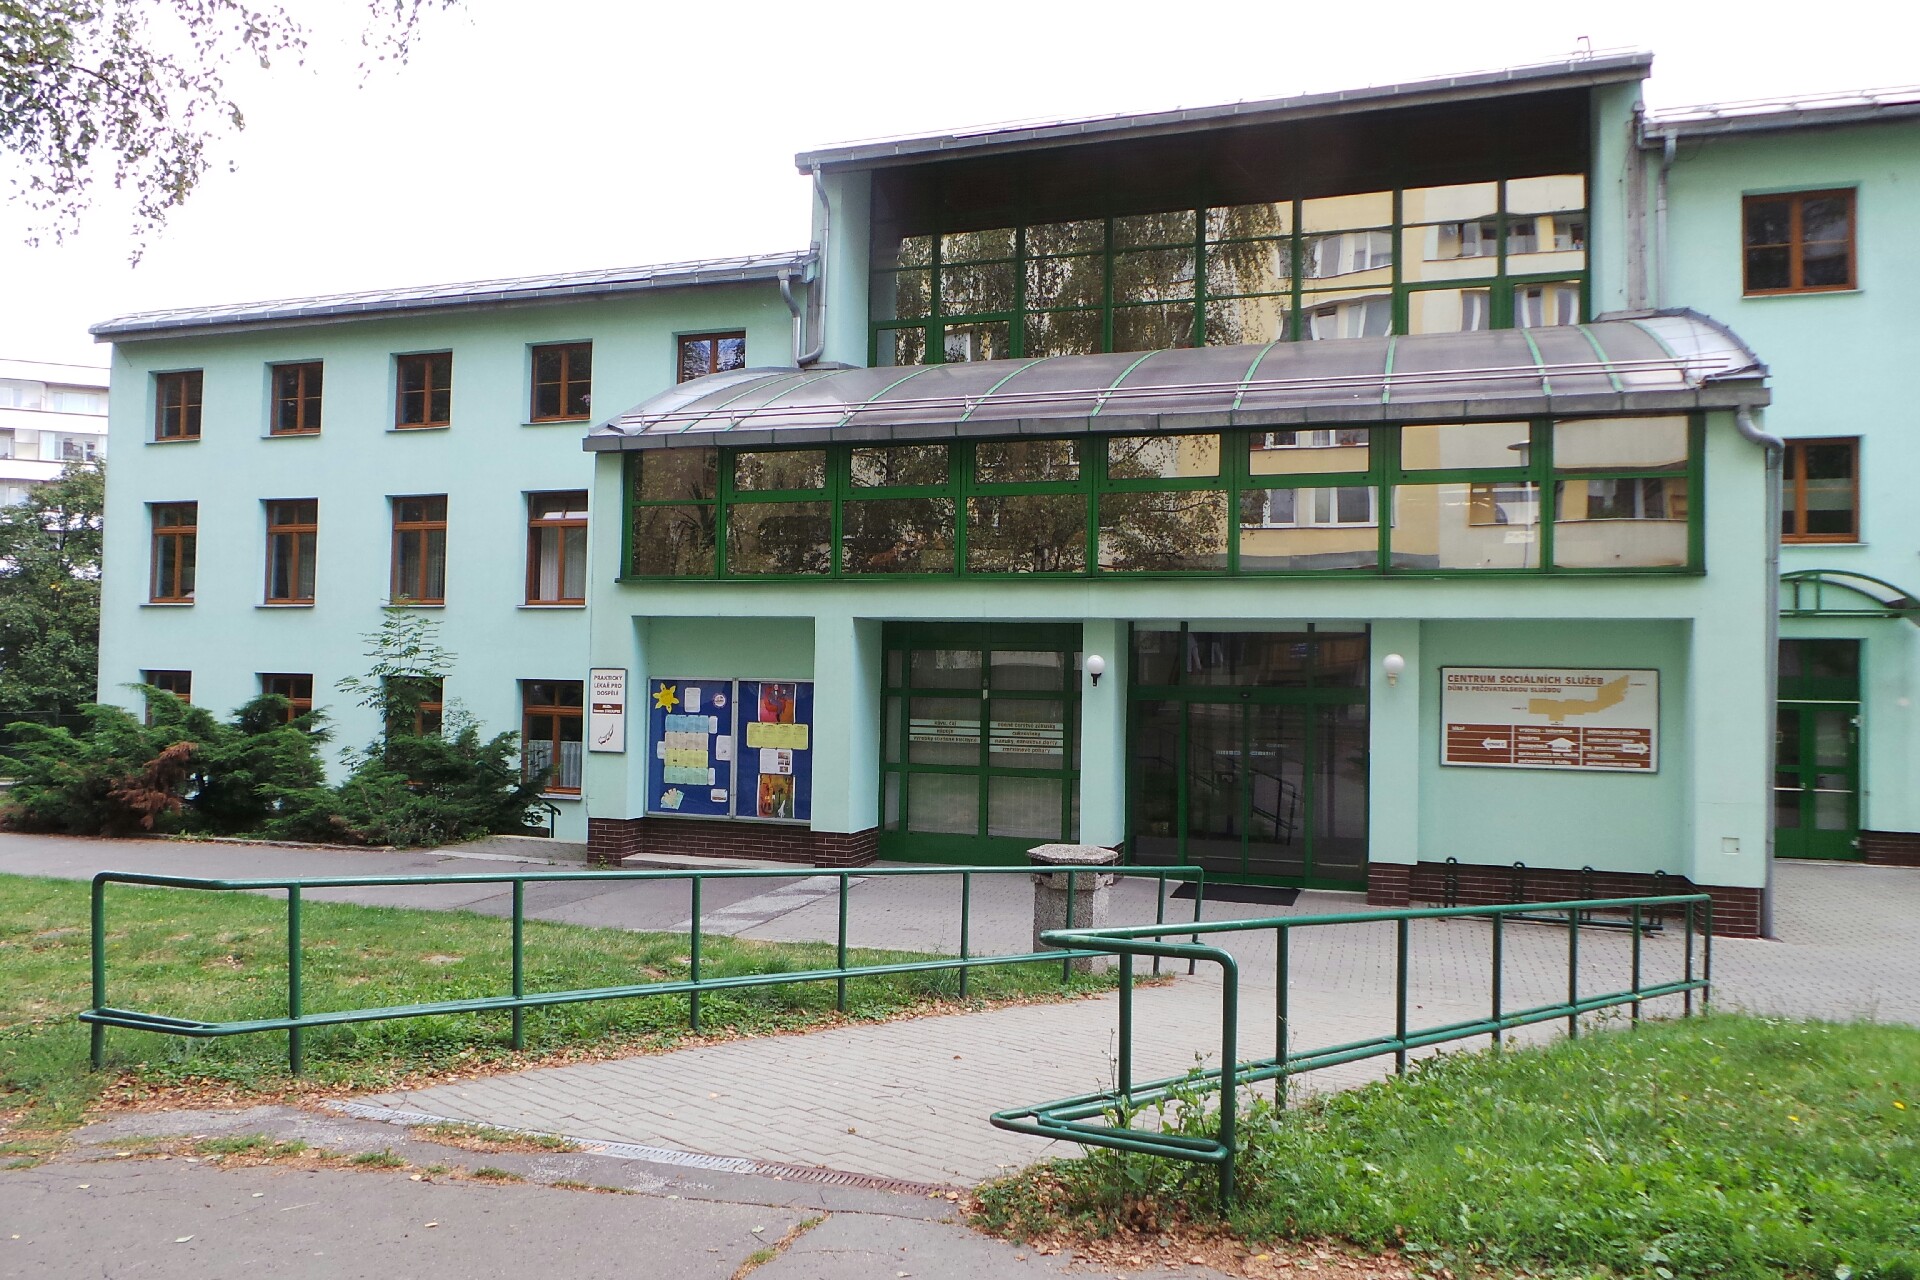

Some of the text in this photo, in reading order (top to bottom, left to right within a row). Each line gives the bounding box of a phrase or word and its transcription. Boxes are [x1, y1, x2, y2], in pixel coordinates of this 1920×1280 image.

[1448, 674, 1603, 684] CENTRUM SOCIÁLNÍCH SLUŽEB
